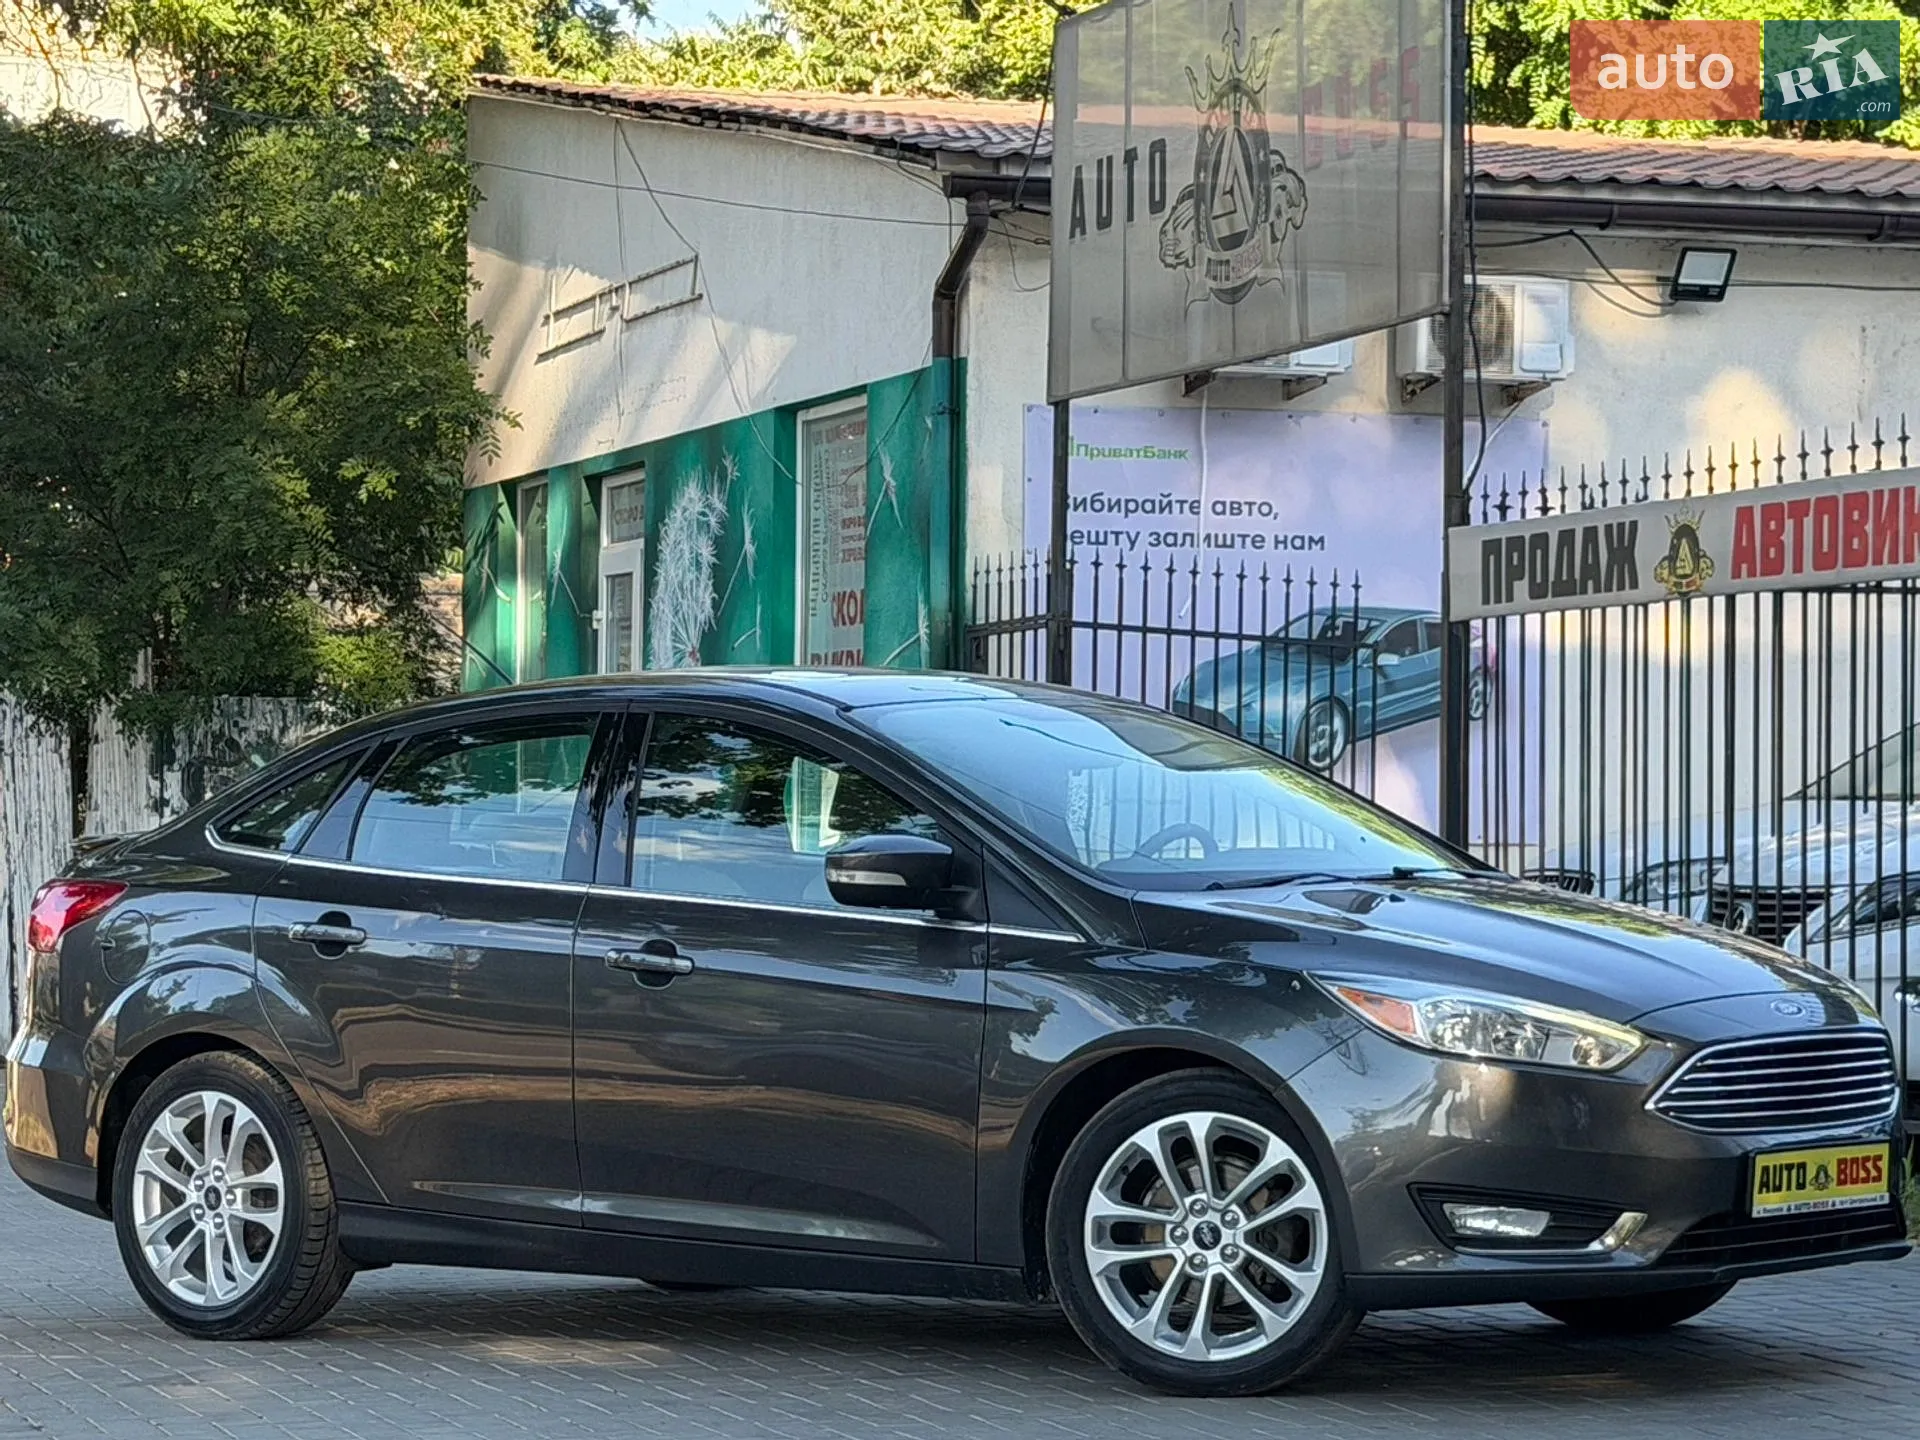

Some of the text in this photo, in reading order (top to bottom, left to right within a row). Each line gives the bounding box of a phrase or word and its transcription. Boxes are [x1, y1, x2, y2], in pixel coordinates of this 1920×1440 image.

[1069, 137, 1167, 240] AUTO
[1077, 442, 1189, 461] ПриватБанк
[1211, 500, 1279, 520] авто,
[1066, 529, 1325, 550] ешту залиште нам
[1481, 519, 1639, 606] ПРОДАЖ
[1758, 1154, 1883, 1194] AUTO BOSS
